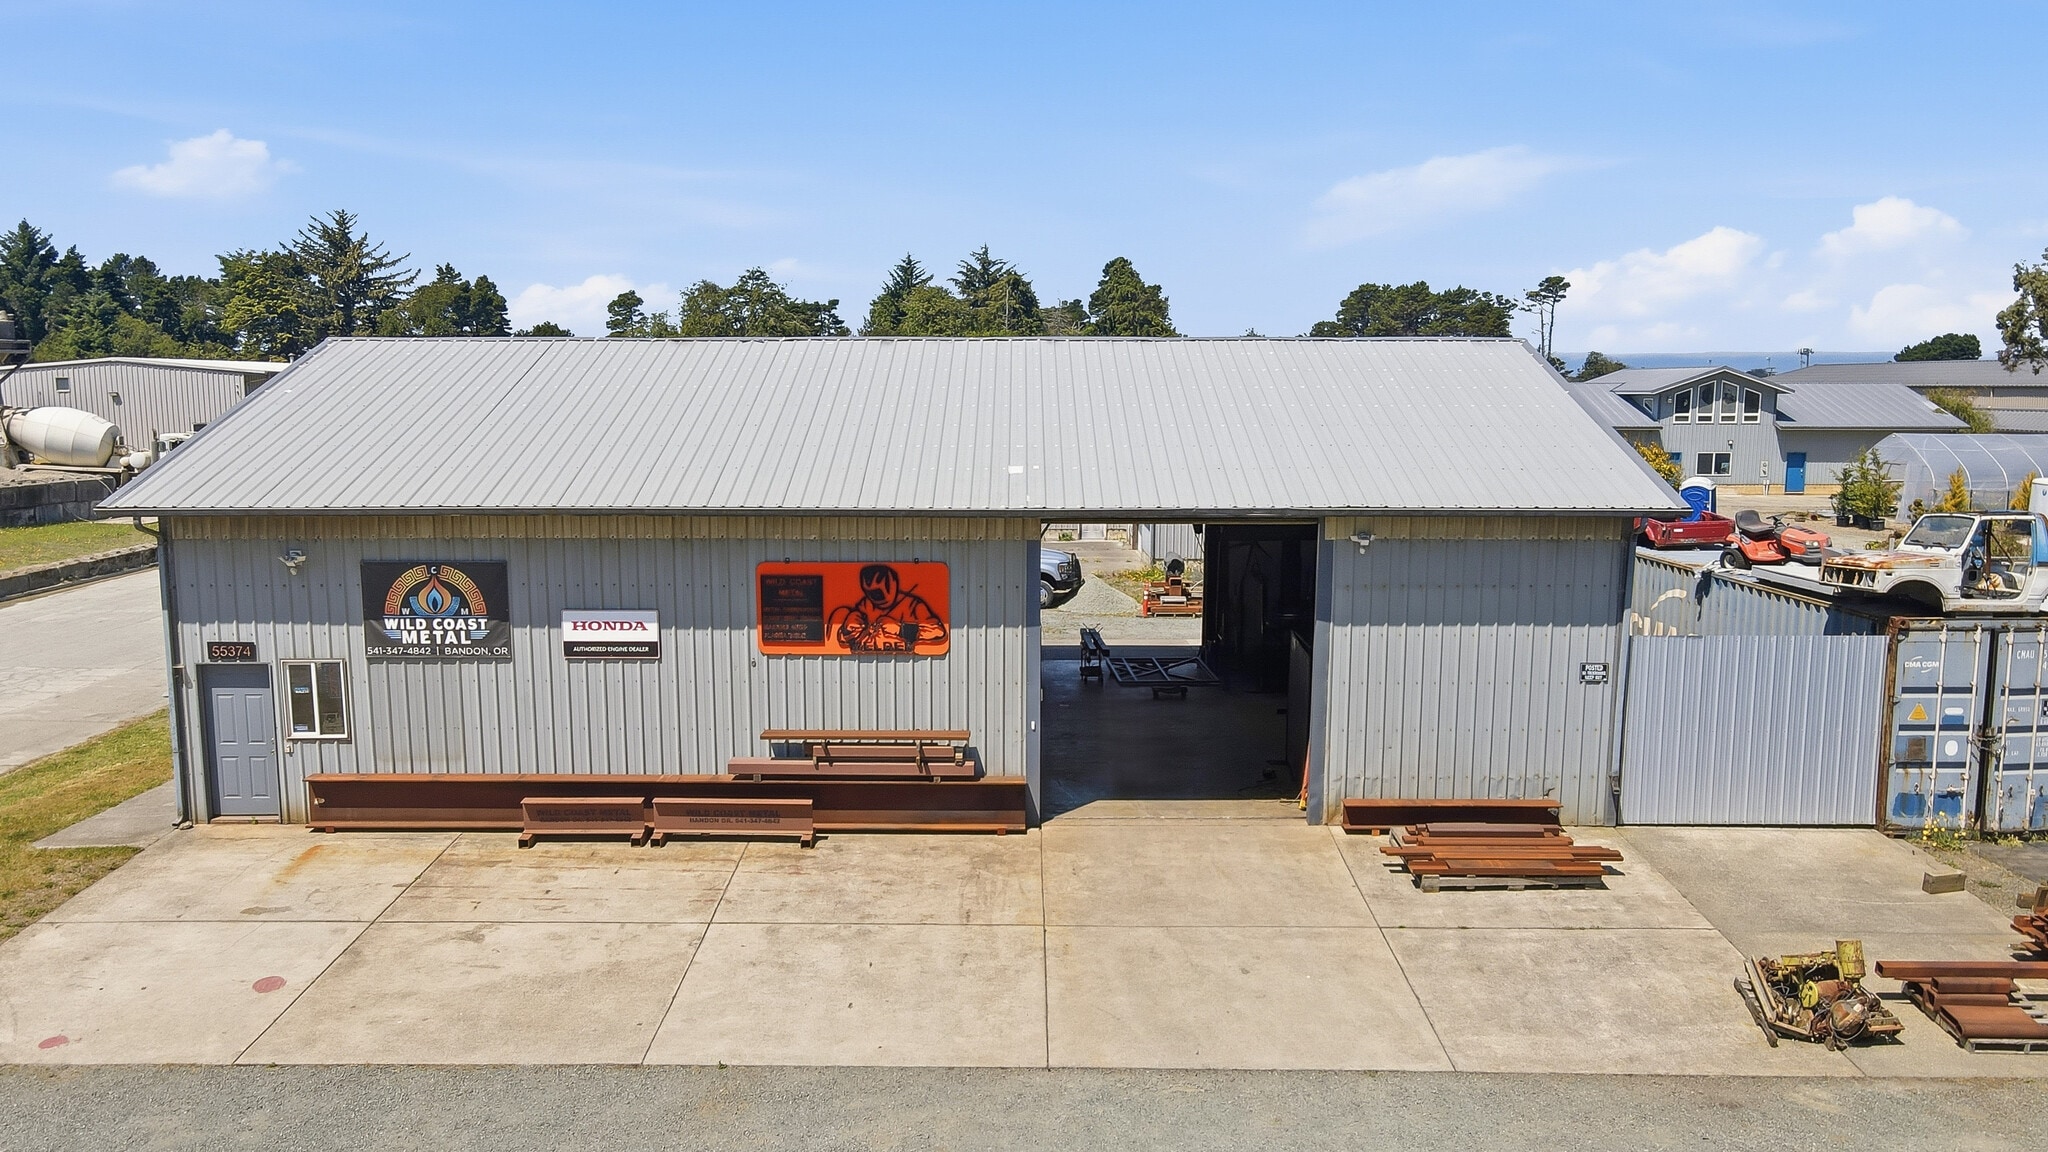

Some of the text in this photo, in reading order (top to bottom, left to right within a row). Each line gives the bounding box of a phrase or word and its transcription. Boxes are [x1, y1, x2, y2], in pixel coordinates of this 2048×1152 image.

[430, 566, 438, 574] C
[401, 607, 469, 615] W M
[384, 618, 488, 630] WILD COAST
[571, 620, 648, 631] HONDA
[402, 630, 472, 645] METAL
[211, 645, 251, 657] 55374
[367, 646, 508, 656] 541-347-4842 BANDON, OR
[2016, 650, 2035, 659] CMAU
